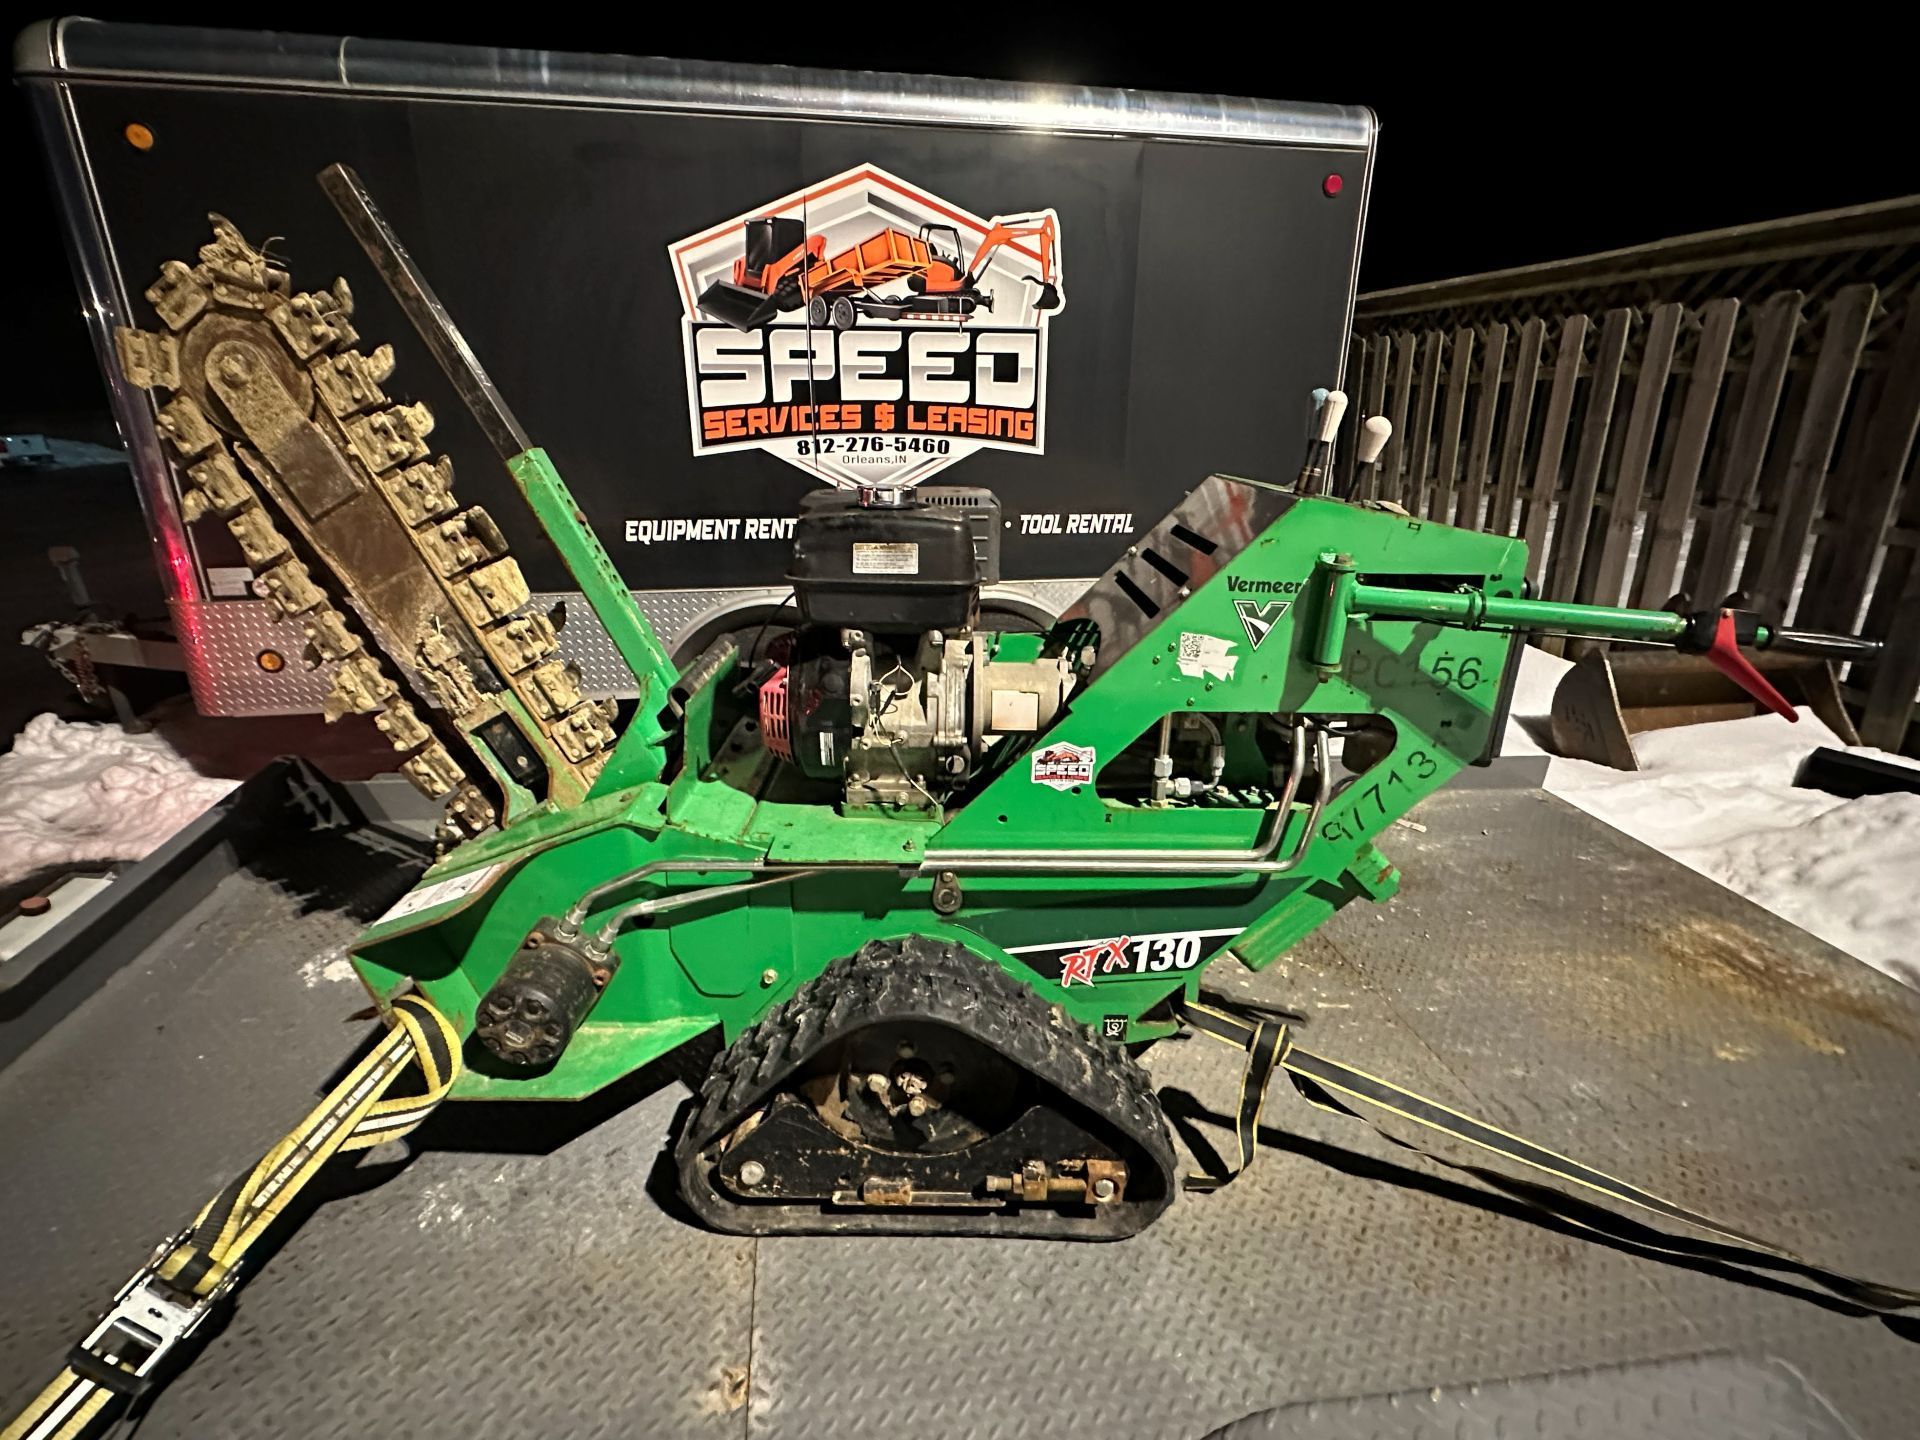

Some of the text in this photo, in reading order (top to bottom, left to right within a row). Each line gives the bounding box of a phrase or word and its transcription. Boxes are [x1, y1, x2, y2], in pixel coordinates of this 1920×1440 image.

[695, 327, 1037, 409] SPEED
[703, 404, 862, 440] SERVICES
[907, 403, 1035, 441] LEASING
[797, 436, 950, 456] 812-276-5460
[625, 518, 741, 546] EQUIPMENT
[1020, 513, 1063, 535] TOOL
[1065, 513, 1135, 534] RENTAL
[1227, 575, 1303, 594] Vermeer
